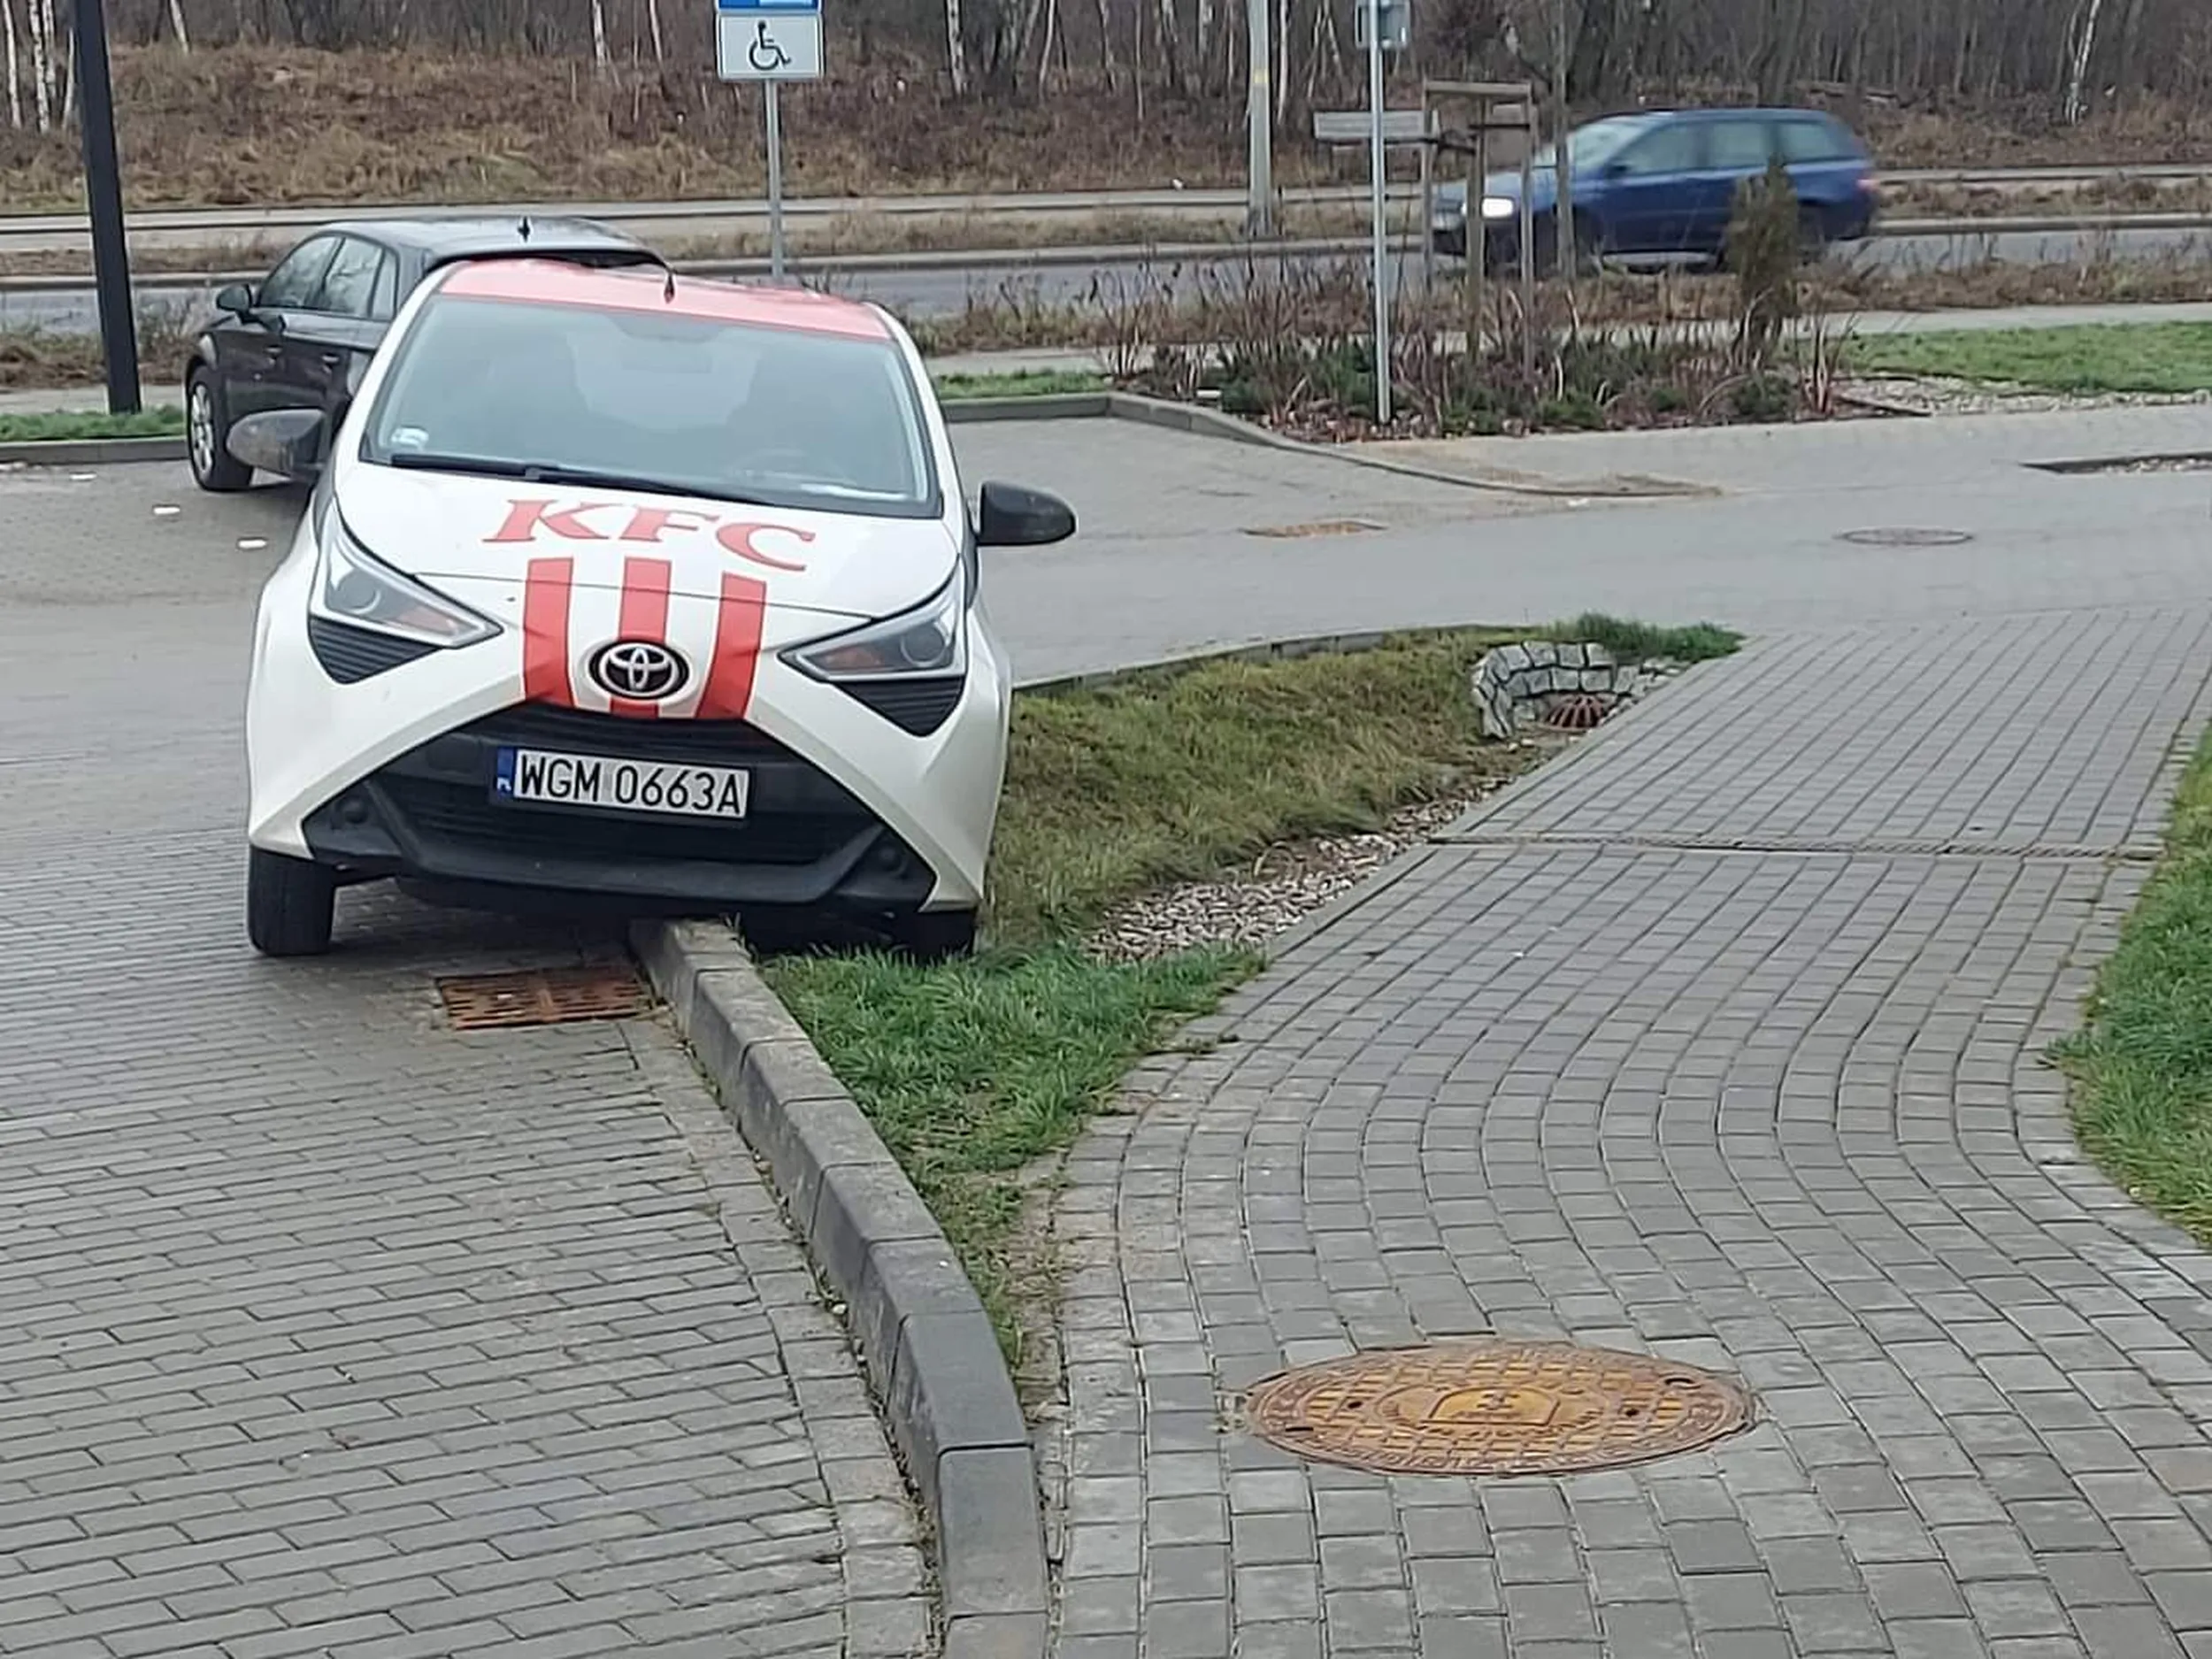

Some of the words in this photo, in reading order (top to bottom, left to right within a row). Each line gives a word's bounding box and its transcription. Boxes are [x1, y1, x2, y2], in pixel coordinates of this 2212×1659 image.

[482, 498, 816, 572] KFC
[520, 754, 602, 803] WGM
[615, 764, 741, 815] 0663A
